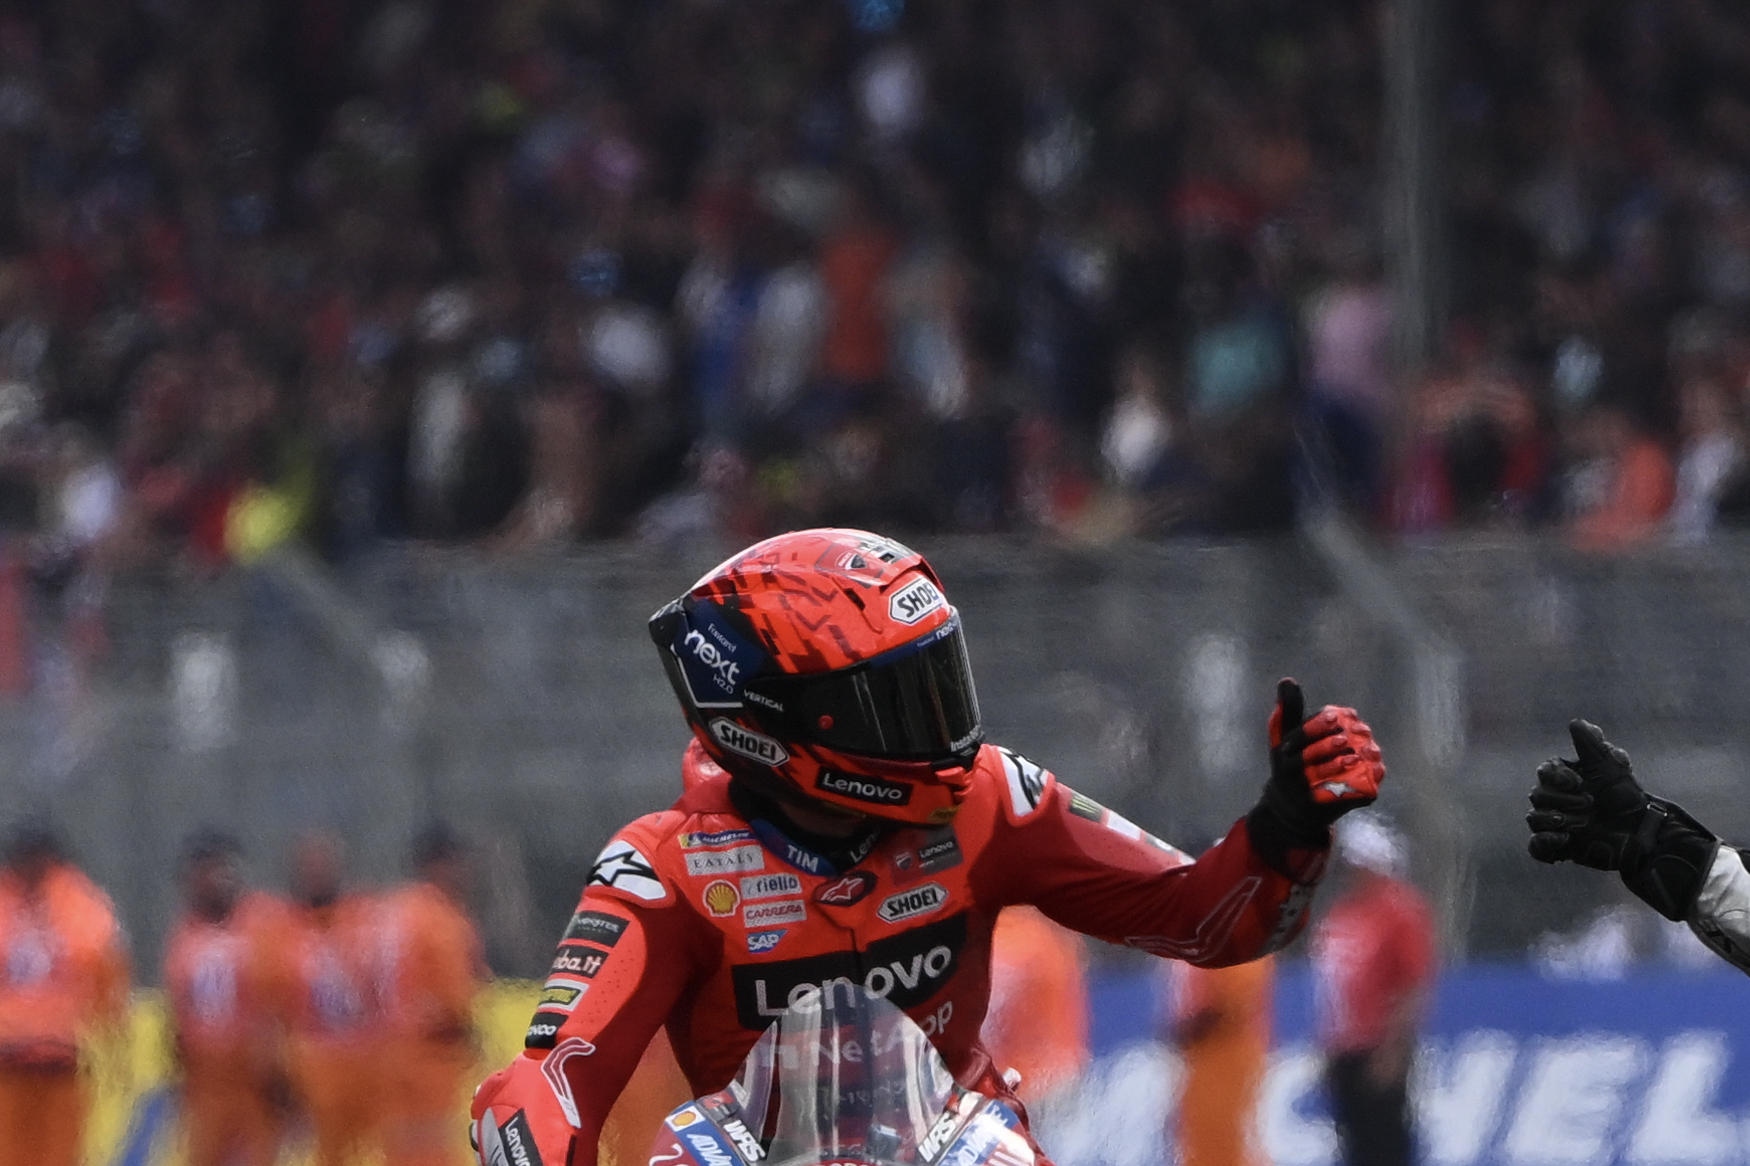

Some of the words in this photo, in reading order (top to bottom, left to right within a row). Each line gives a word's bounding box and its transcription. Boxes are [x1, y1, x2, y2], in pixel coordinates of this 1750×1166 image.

[684, 629, 741, 685] next
[744, 688, 785, 713] VERTICAL
[720, 724, 778, 764] SHOEI
[823, 772, 903, 800] Lenovo
[694, 853, 754, 869] EATALY
[786, 844, 820, 873] TIM
[918, 841, 955, 860] Lenovo
[756, 876, 799, 893] riello
[746, 905, 803, 920] CARRERA
[886, 888, 940, 918] SHOEI
[747, 933, 779, 951] SAP
[553, 948, 603, 975] ba.it
[755, 945, 952, 1017] Lenovo
[724, 1119, 766, 1163] WRS
[918, 1112, 962, 1163] WRS
